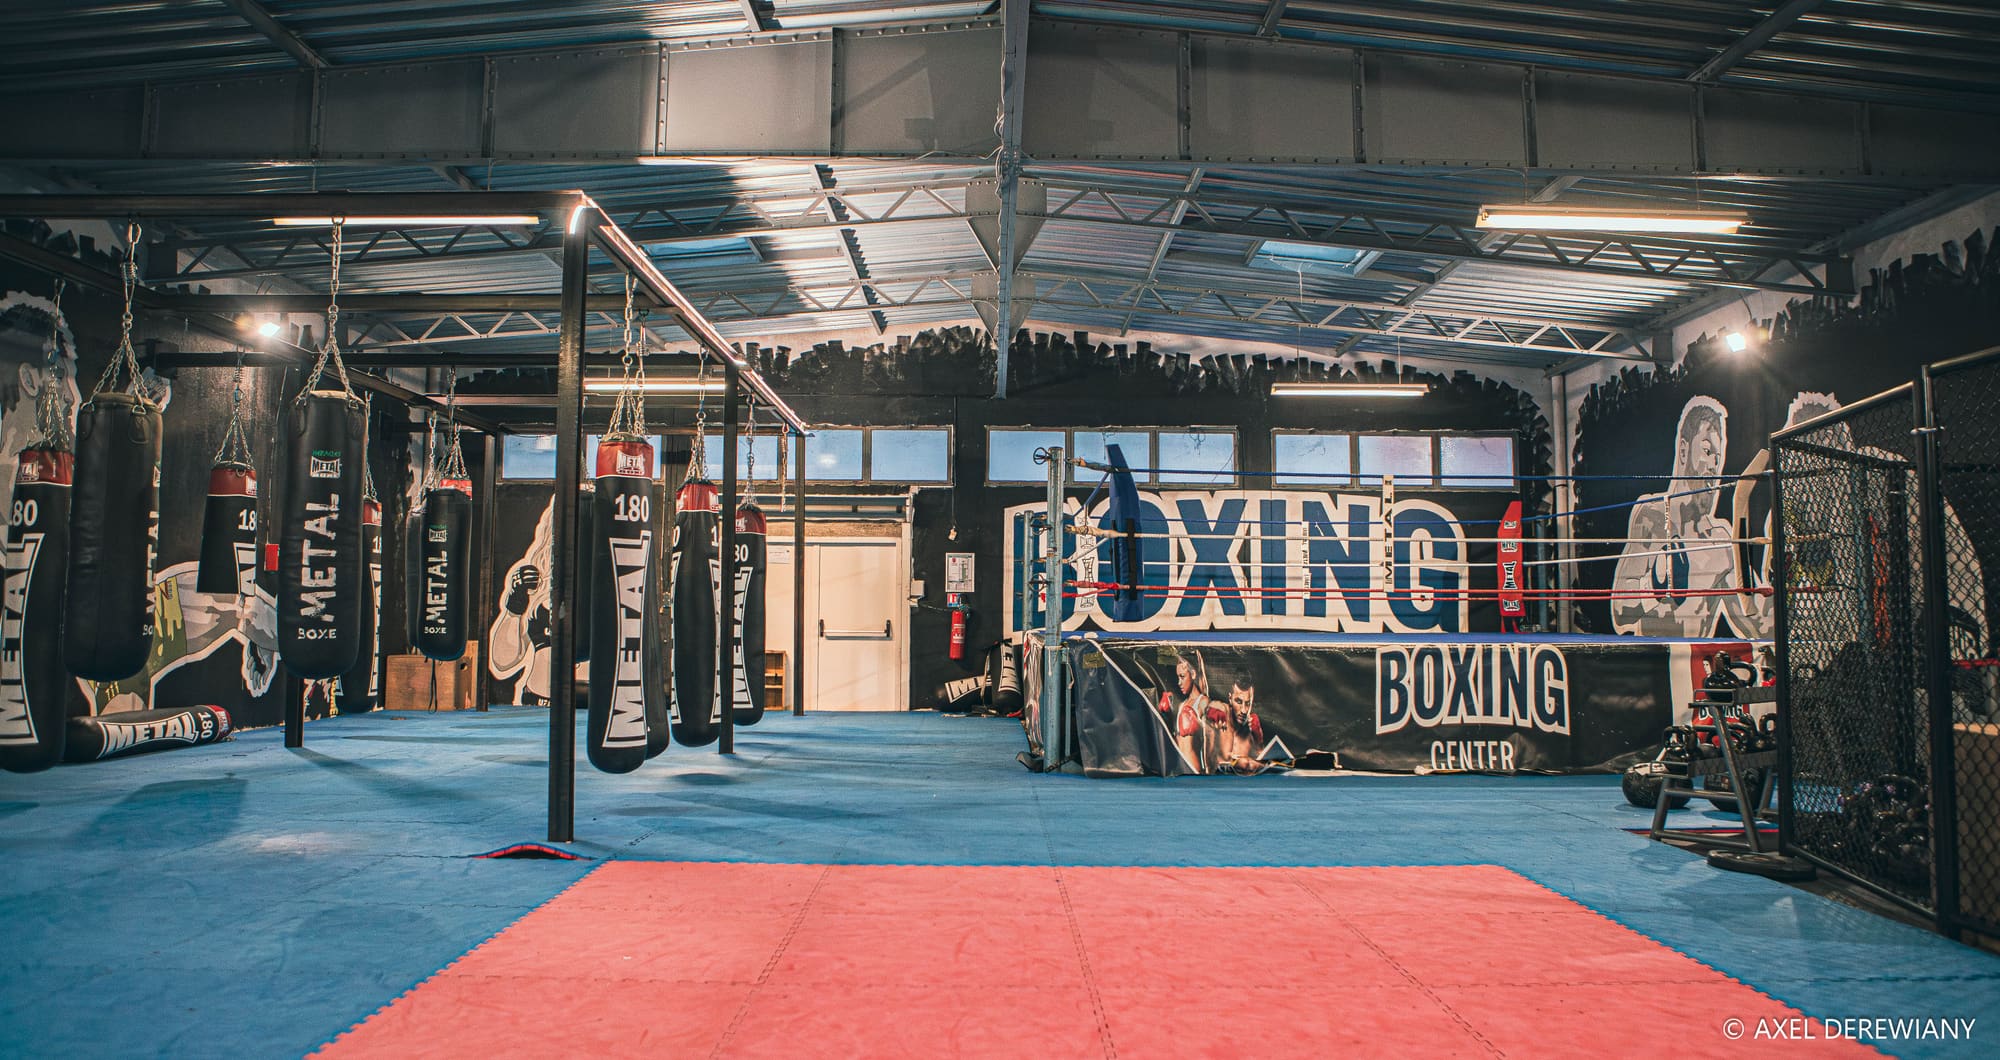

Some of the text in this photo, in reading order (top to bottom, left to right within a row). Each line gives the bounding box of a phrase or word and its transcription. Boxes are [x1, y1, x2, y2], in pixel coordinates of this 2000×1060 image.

[312, 459, 339, 473] METAL
[10, 499, 38, 527] 80
[238, 509, 257, 531] 18
[614, 493, 650, 523] 180
[301, 493, 340, 622] METAL
[1004, 491, 1467, 636] BOXING
[1503, 561, 1517, 590] METAL
[426, 550, 448, 625] METAL
[0, 535, 43, 742] METAL
[298, 627, 337, 640] BOXE
[606, 532, 651, 745] METAL
[1376, 644, 1571, 735] BOXING
[99, 713, 197, 757] METAL
[198, 711, 212, 740] 180
[1431, 740, 1515, 770] CENTER
